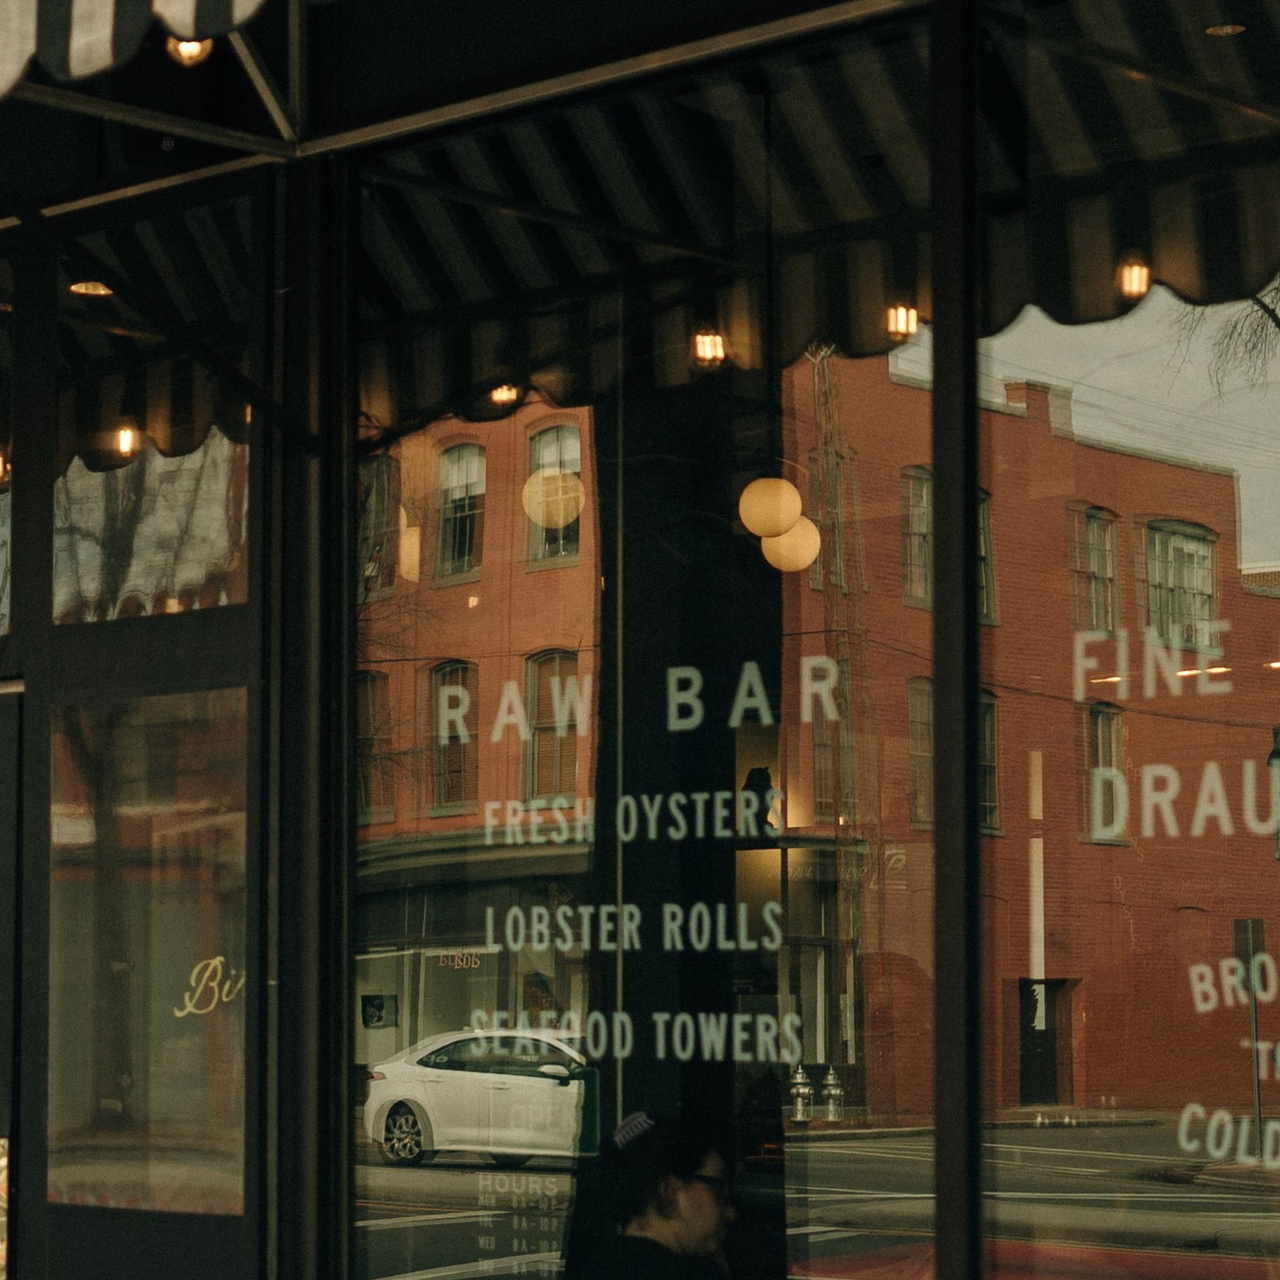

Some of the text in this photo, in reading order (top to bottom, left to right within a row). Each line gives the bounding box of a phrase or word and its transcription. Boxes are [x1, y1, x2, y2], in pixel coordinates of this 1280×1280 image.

[1073, 619, 1234, 702] FINE
[439, 655, 840, 746] RAW BAR
[483, 789, 785, 846] FRESH OYSTERS
[485, 901, 783, 953] LOBSTER ROLLS
[173, 955, 246, 1018] Bi
[470, 1009, 803, 1065] SEAFOOD TOWERS
[478, 1174, 558, 1196] HOURS
